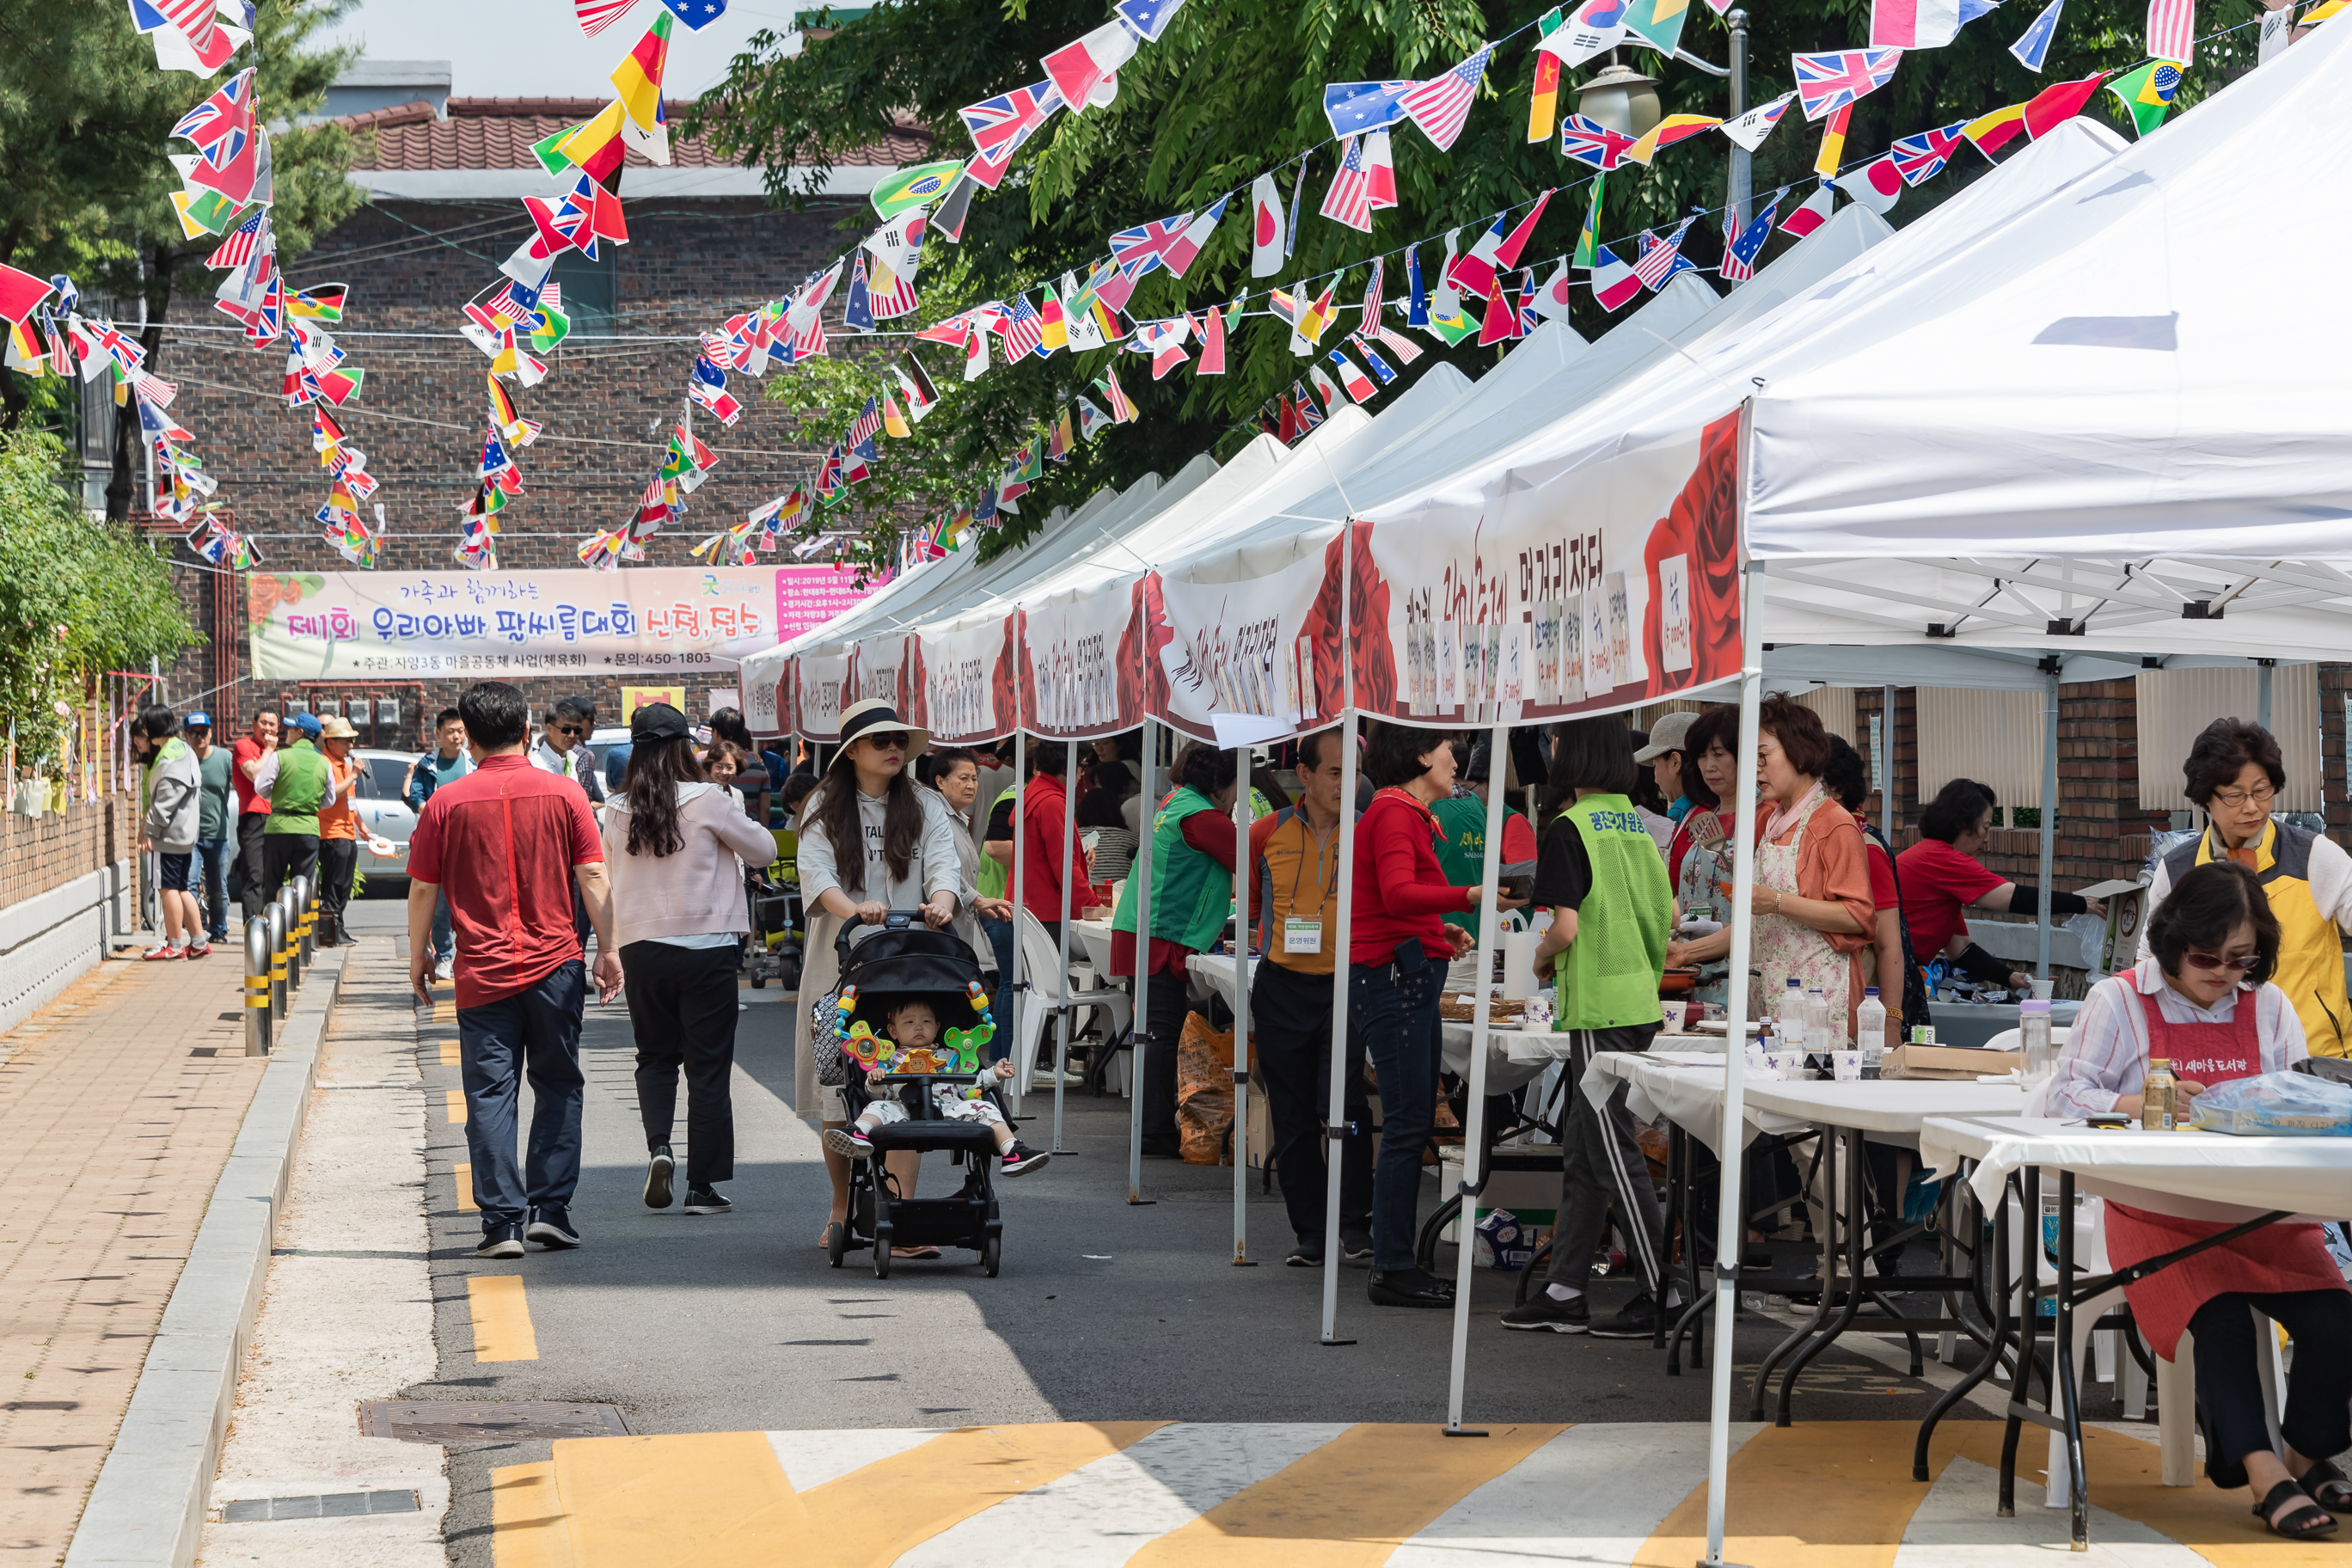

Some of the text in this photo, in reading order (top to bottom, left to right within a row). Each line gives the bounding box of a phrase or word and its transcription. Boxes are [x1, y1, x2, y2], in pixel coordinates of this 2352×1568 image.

[401, 578, 538, 605] 가족과 함께하는
[286, 603, 758, 642] 제1회 우리아빠 팔씨름대회 신청,접수
[364, 653, 587, 671] 주관:자양3동 마을공동체 사업(체육회)
[613, 652, 712, 666] 문의:450-1803
[1459, 830, 1485, 851] 새마
[2184, 1058, 2247, 1074] 새마을도서관
